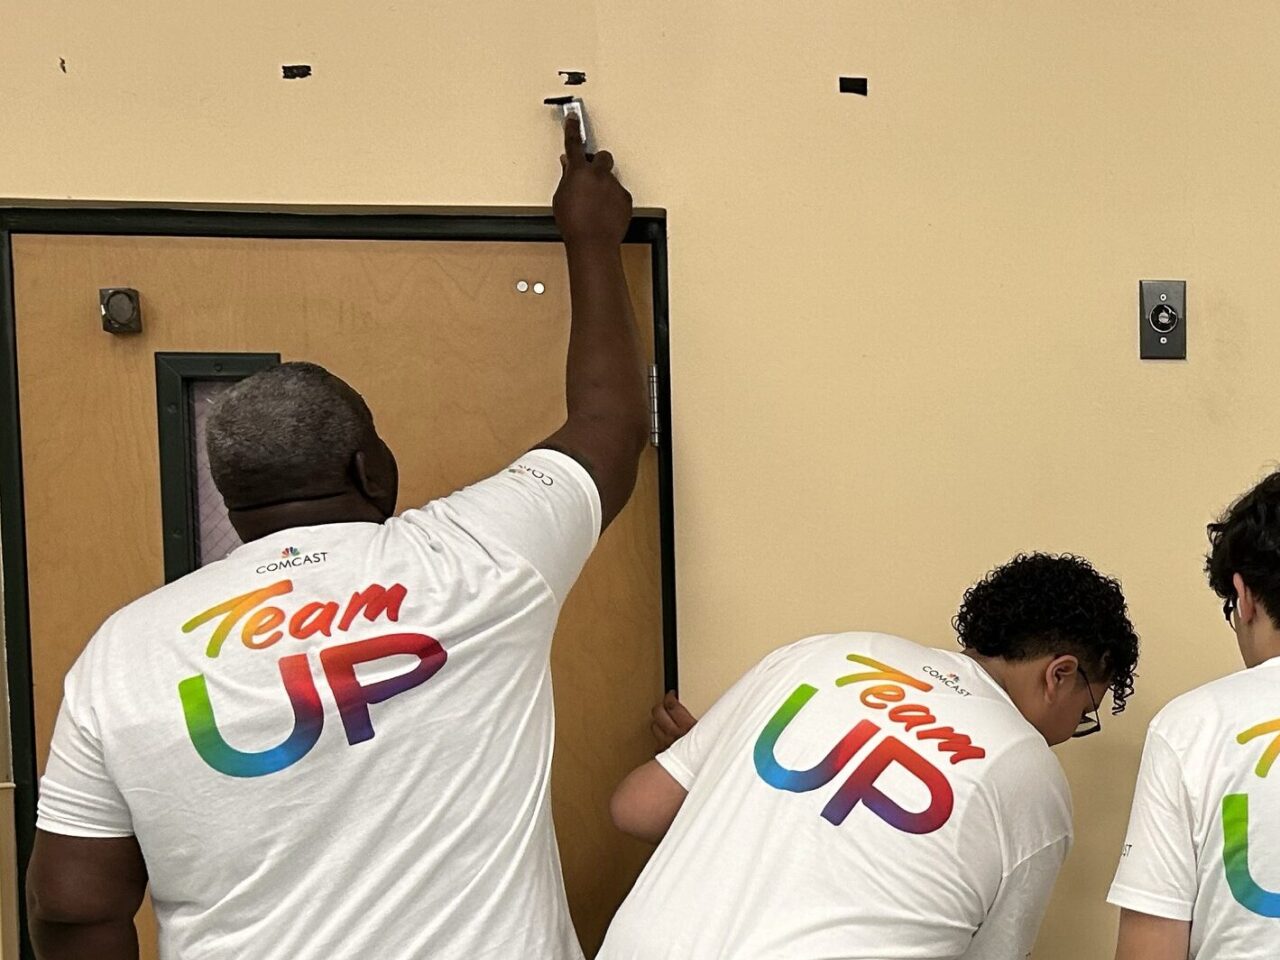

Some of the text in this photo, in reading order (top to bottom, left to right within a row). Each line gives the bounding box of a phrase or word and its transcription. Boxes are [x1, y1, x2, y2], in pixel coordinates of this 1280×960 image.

[255, 552, 328, 575] COMCAST
[181, 578, 408, 659] Team
[177, 632, 448, 778] UP
[834, 653, 986, 765] Team
[921, 665, 973, 698] COMCAST
[753, 683, 954, 835] UP
